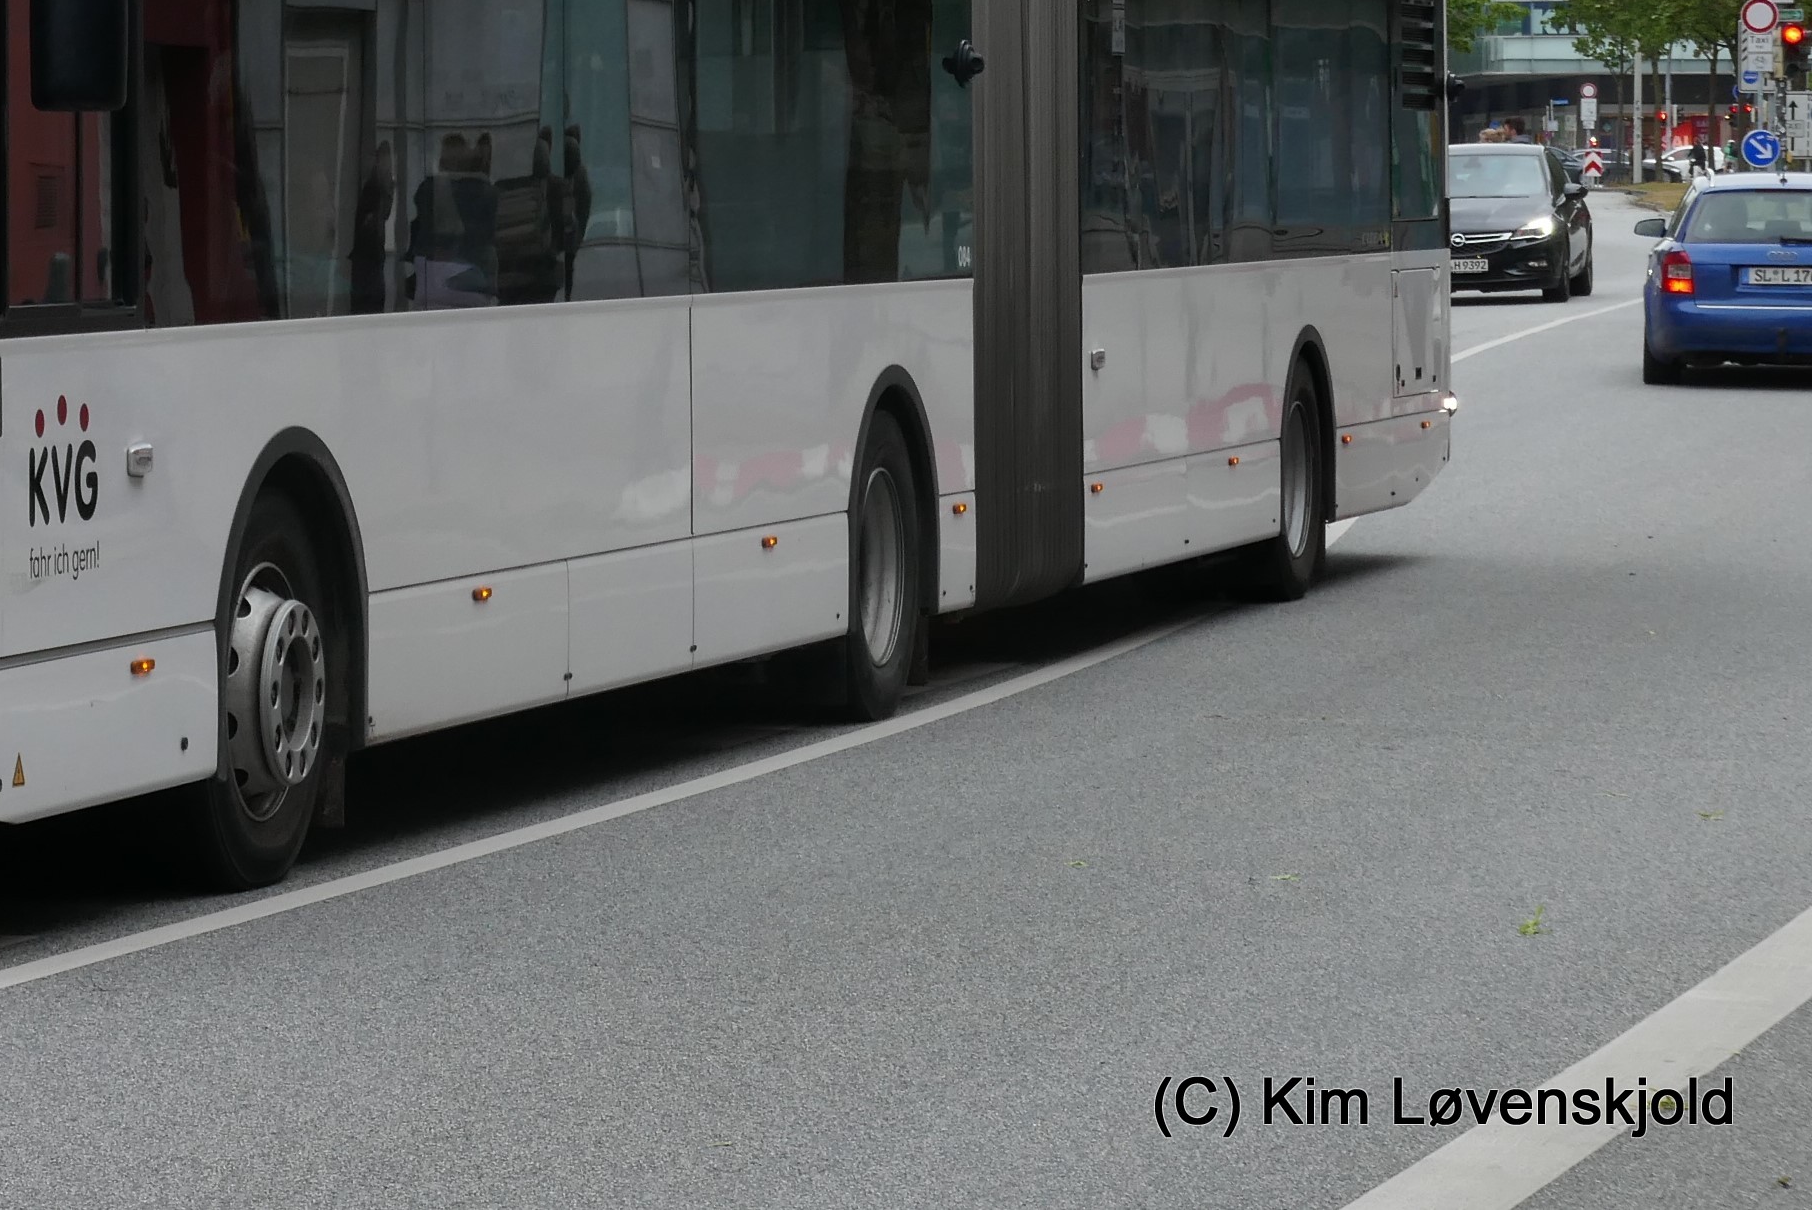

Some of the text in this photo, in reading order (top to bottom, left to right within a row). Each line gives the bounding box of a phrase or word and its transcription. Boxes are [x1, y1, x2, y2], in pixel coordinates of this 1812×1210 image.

[1749, 35, 1769, 44] Taxi
[957, 245, 971, 267] 084
[1463, 260, 1487, 271] 9392
[1754, 269, 1771, 283] SL
[1781, 269, 1790, 282] L
[29, 439, 99, 528] KVG
[29, 540, 100, 581] fahr ich gern!
